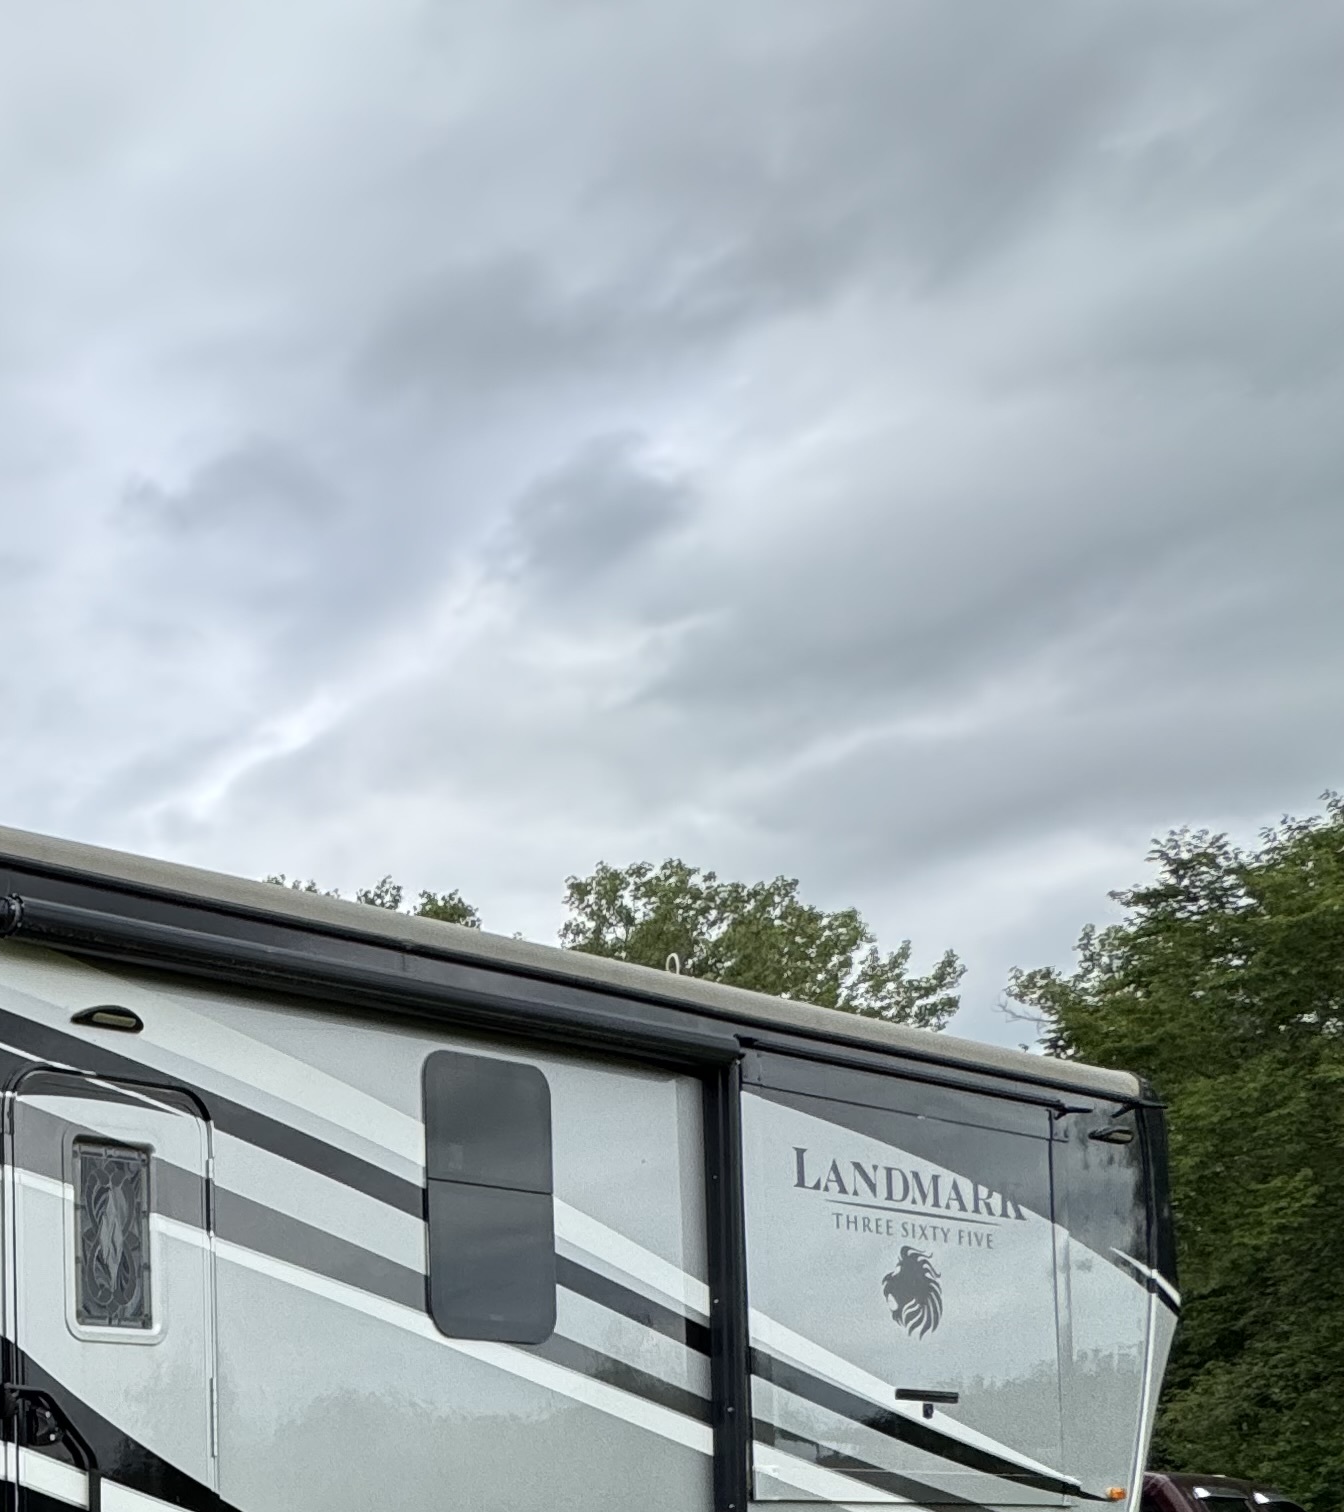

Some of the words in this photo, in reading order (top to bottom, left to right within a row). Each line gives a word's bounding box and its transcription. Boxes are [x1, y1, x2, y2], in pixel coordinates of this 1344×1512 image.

[832, 1213, 894, 1236] THREE
[901, 1221, 951, 1245] SIXTY
[958, 1230, 994, 1249] FIVE
